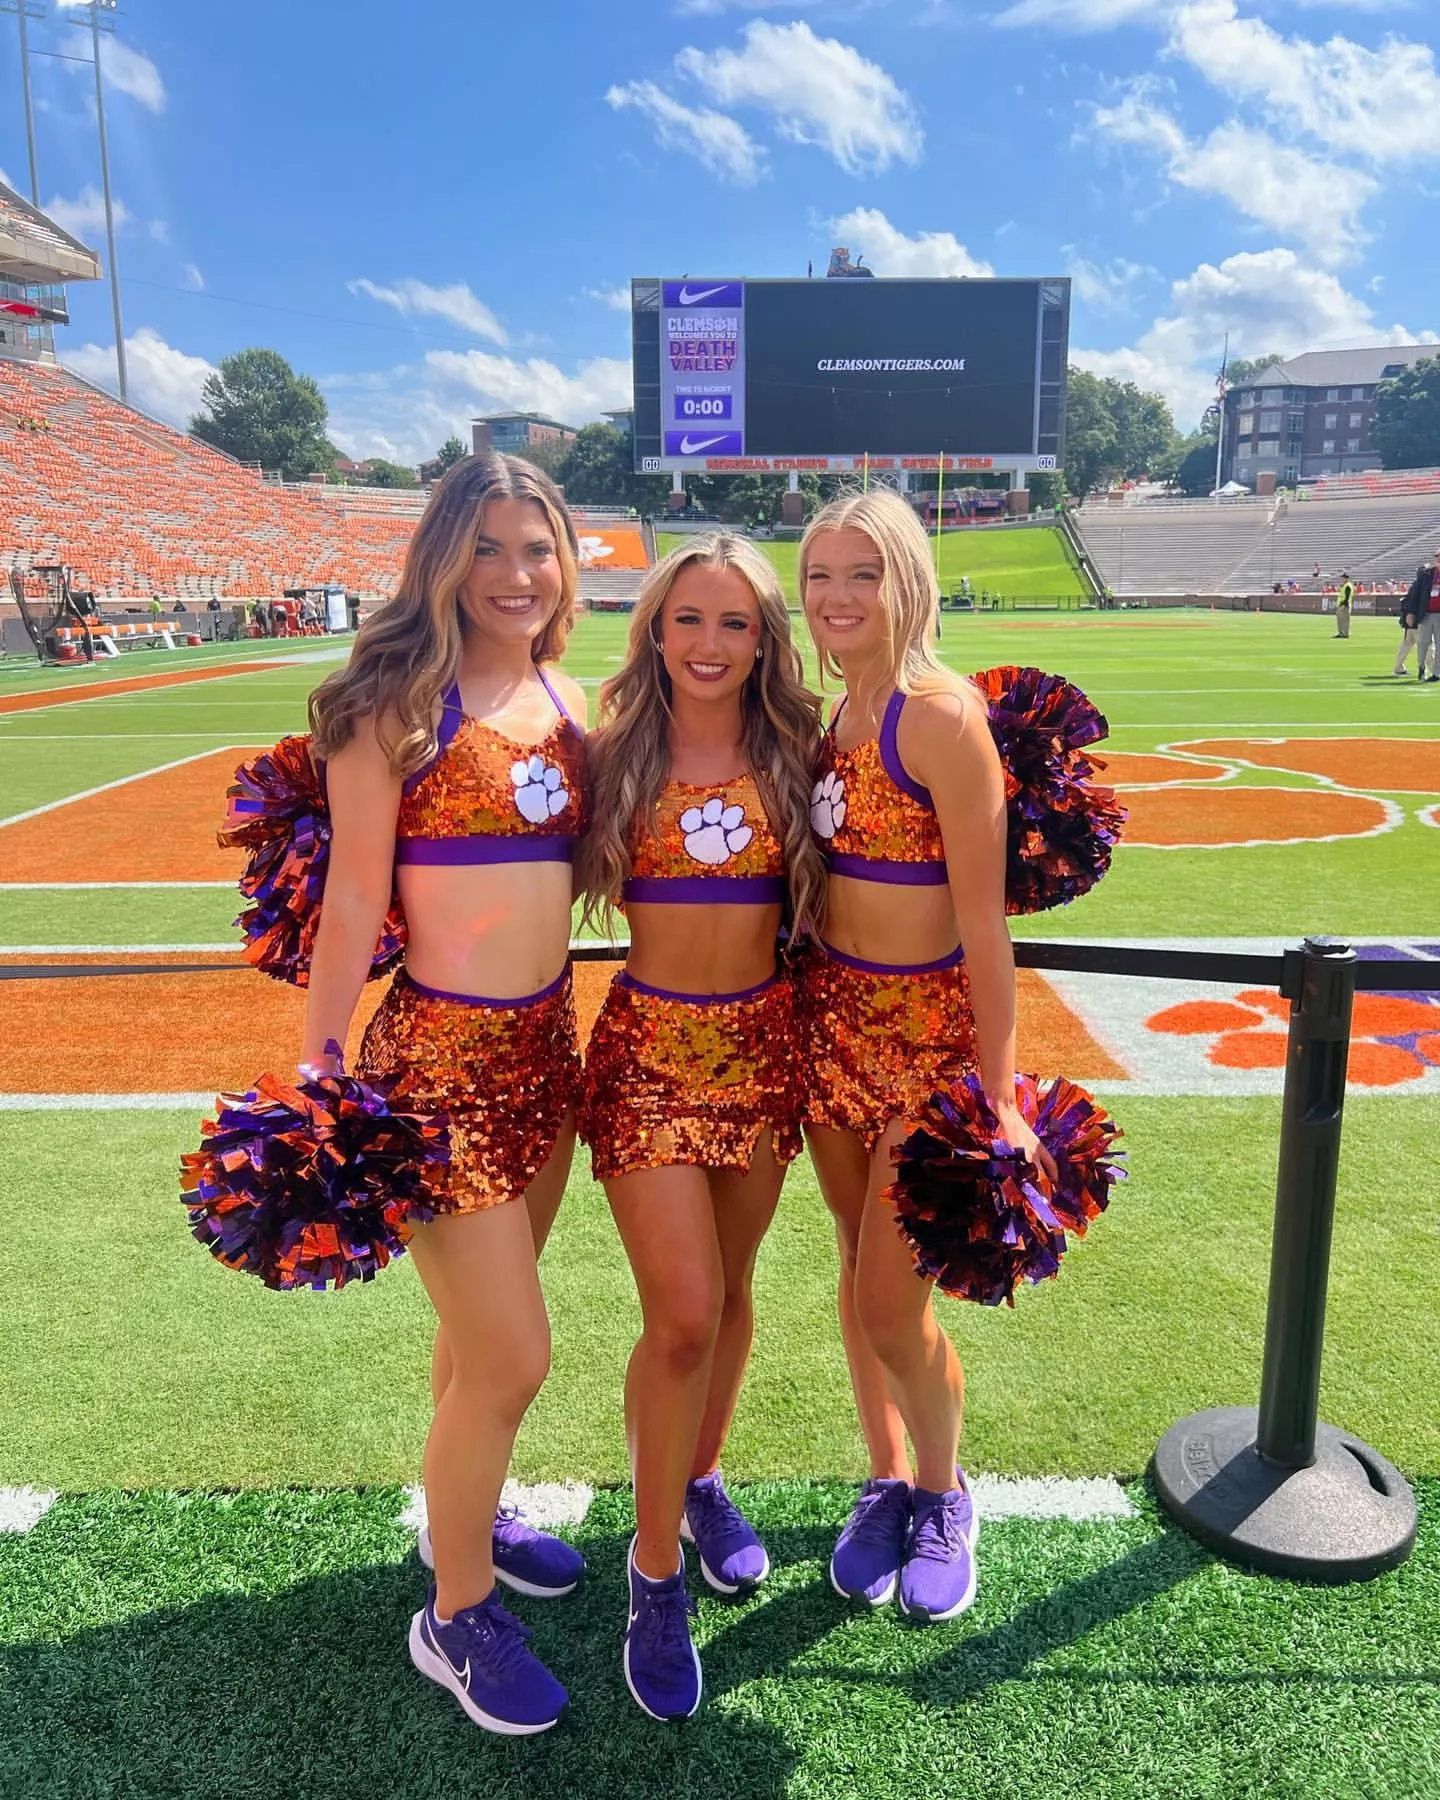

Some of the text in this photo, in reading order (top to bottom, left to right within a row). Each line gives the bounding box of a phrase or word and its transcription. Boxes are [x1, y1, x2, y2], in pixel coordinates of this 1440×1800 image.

[668, 318, 737, 331] CLEMSON
[669, 340, 736, 356] DEATH
[670, 358, 735, 371] VALLEY
[817, 359, 965, 371] CLEMSONTIGERS.COM
[683, 399, 723, 415] 0:00
